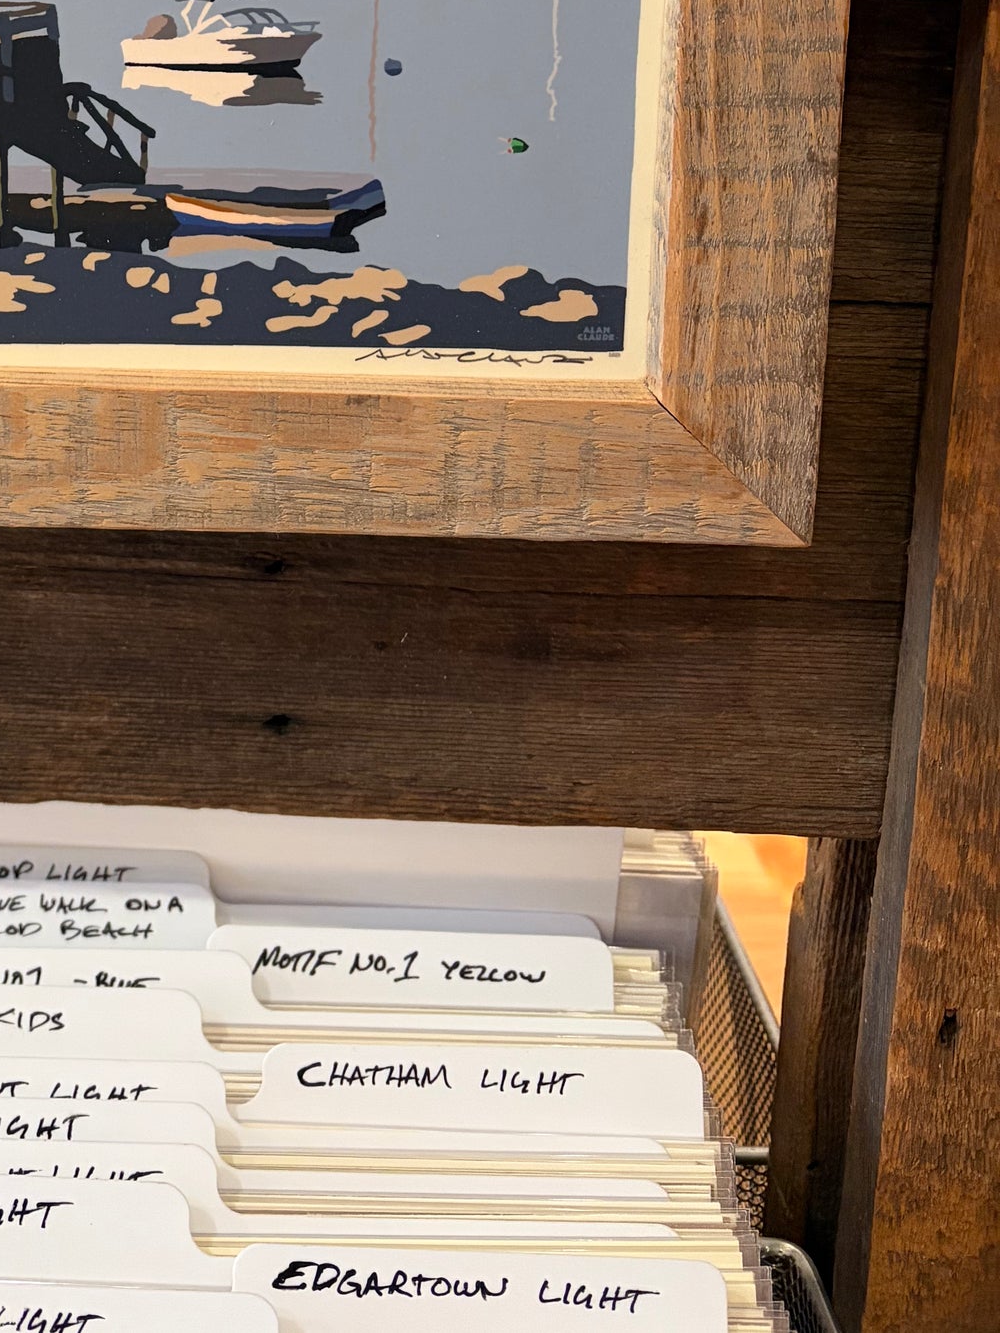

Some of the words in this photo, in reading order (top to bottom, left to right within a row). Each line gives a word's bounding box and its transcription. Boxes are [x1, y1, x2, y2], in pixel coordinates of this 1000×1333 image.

[576, 333, 615, 341] CLAUDE
[582, 326, 611, 334] ALAN
[45, 864, 135, 882] LIGHT
[39, 893, 108, 915] WALK
[125, 898, 161, 912] ON
[167, 896, 184, 913] A
[59, 921, 153, 941] BEACH
[251, 945, 343, 977] MOTIF
[441, 960, 546, 984] YELLOW
[296, 1061, 452, 1089] CHATHAM
[480, 1068, 585, 1096] LIGHT
[49, 1082, 158, 1101] LIGHT
[271, 1260, 509, 1301] EDGARTOWN
[538, 1279, 661, 1314] LIGHT
